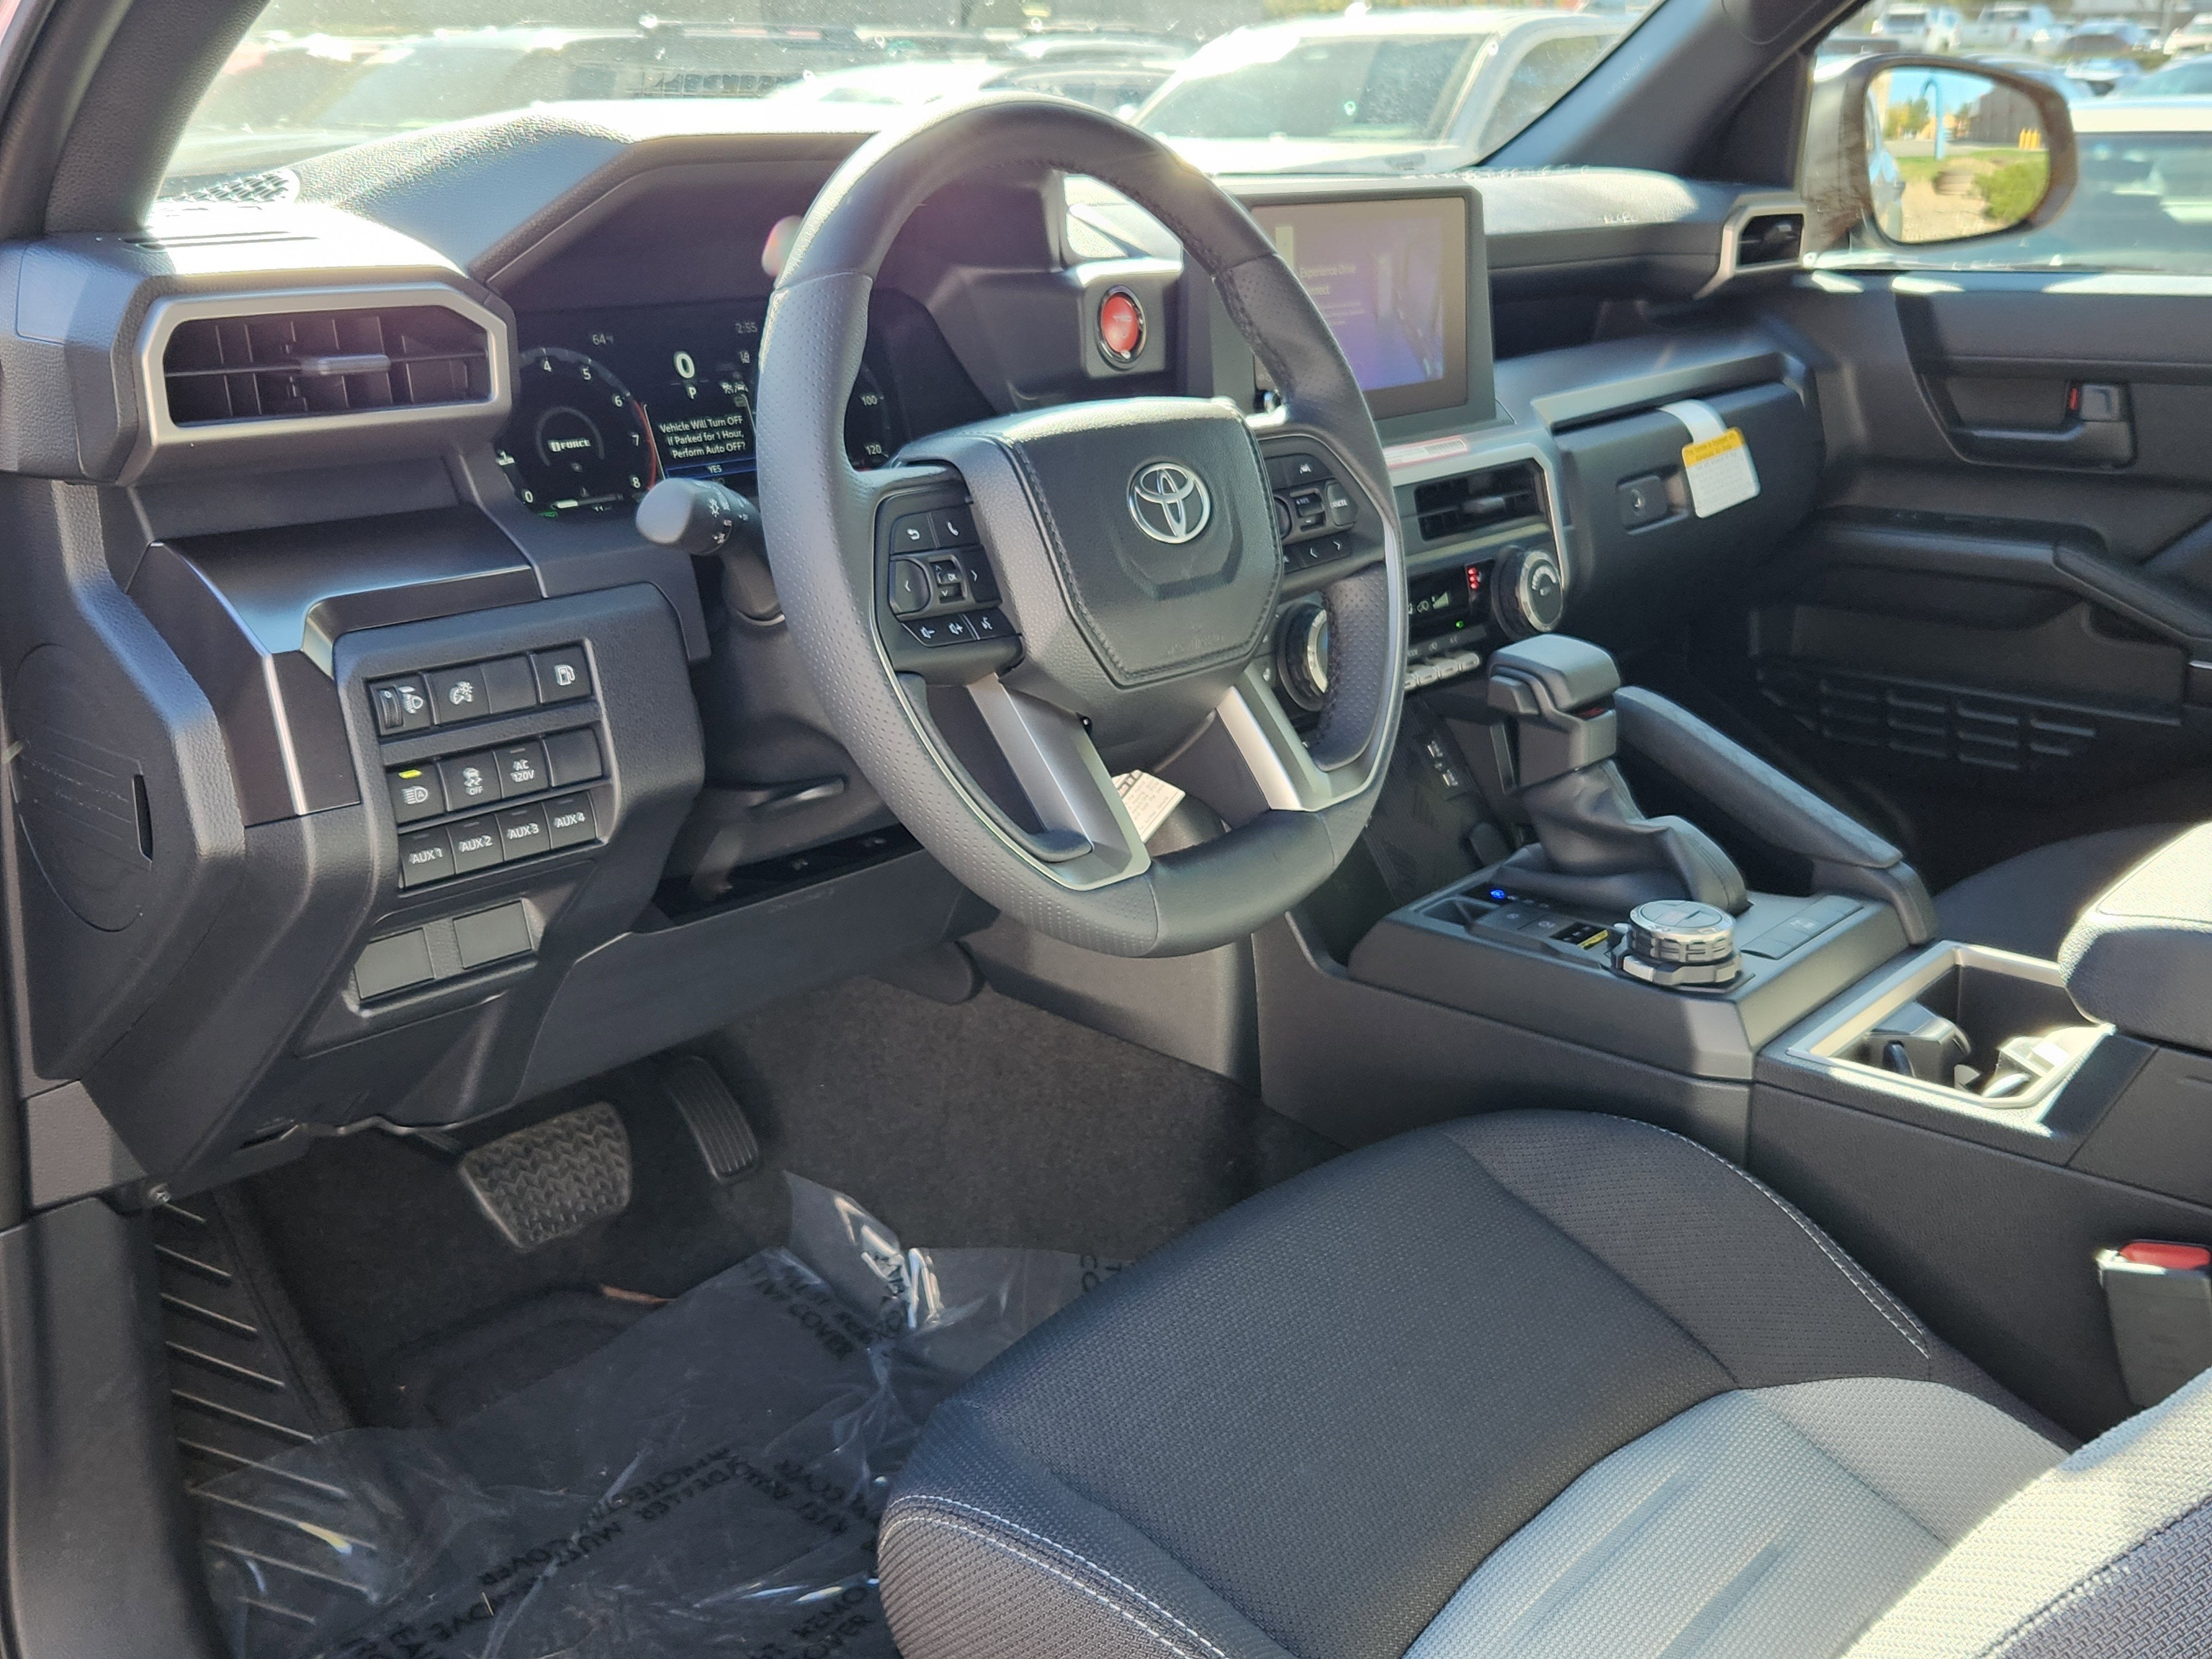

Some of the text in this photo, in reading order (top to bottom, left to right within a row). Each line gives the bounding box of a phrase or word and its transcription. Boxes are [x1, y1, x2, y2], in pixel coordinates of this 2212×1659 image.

[544, 361, 552, 372] 4
[675, 352, 695, 378] 0
[582, 367, 591, 380] 5
[688, 387, 696, 399] P
[614, 395, 623, 407] 6
[862, 395, 878, 406] 100
[659, 415, 743, 434] Vehicle Will Turn OFF
[631, 434, 639, 446] 7
[667, 436, 674, 446] If
[675, 434, 702, 445] Parked
[703, 432, 715, 441] for
[716, 431, 721, 440] 1
[672, 442, 746, 459] Perform Auto OFF?
[865, 445, 882, 455] 120
[708, 465, 722, 474] YES
[632, 477, 641, 488] 8
[525, 491, 533, 503] 0
[514, 760, 529, 770] AC
[511, 770, 535, 783] 120V
[466, 786, 483, 796] OFF
[555, 811, 585, 828] AUX 4
[509, 823, 540, 839] AUX 3
[460, 836, 492, 852] AUX 2
[411, 851, 434, 864] AUX
